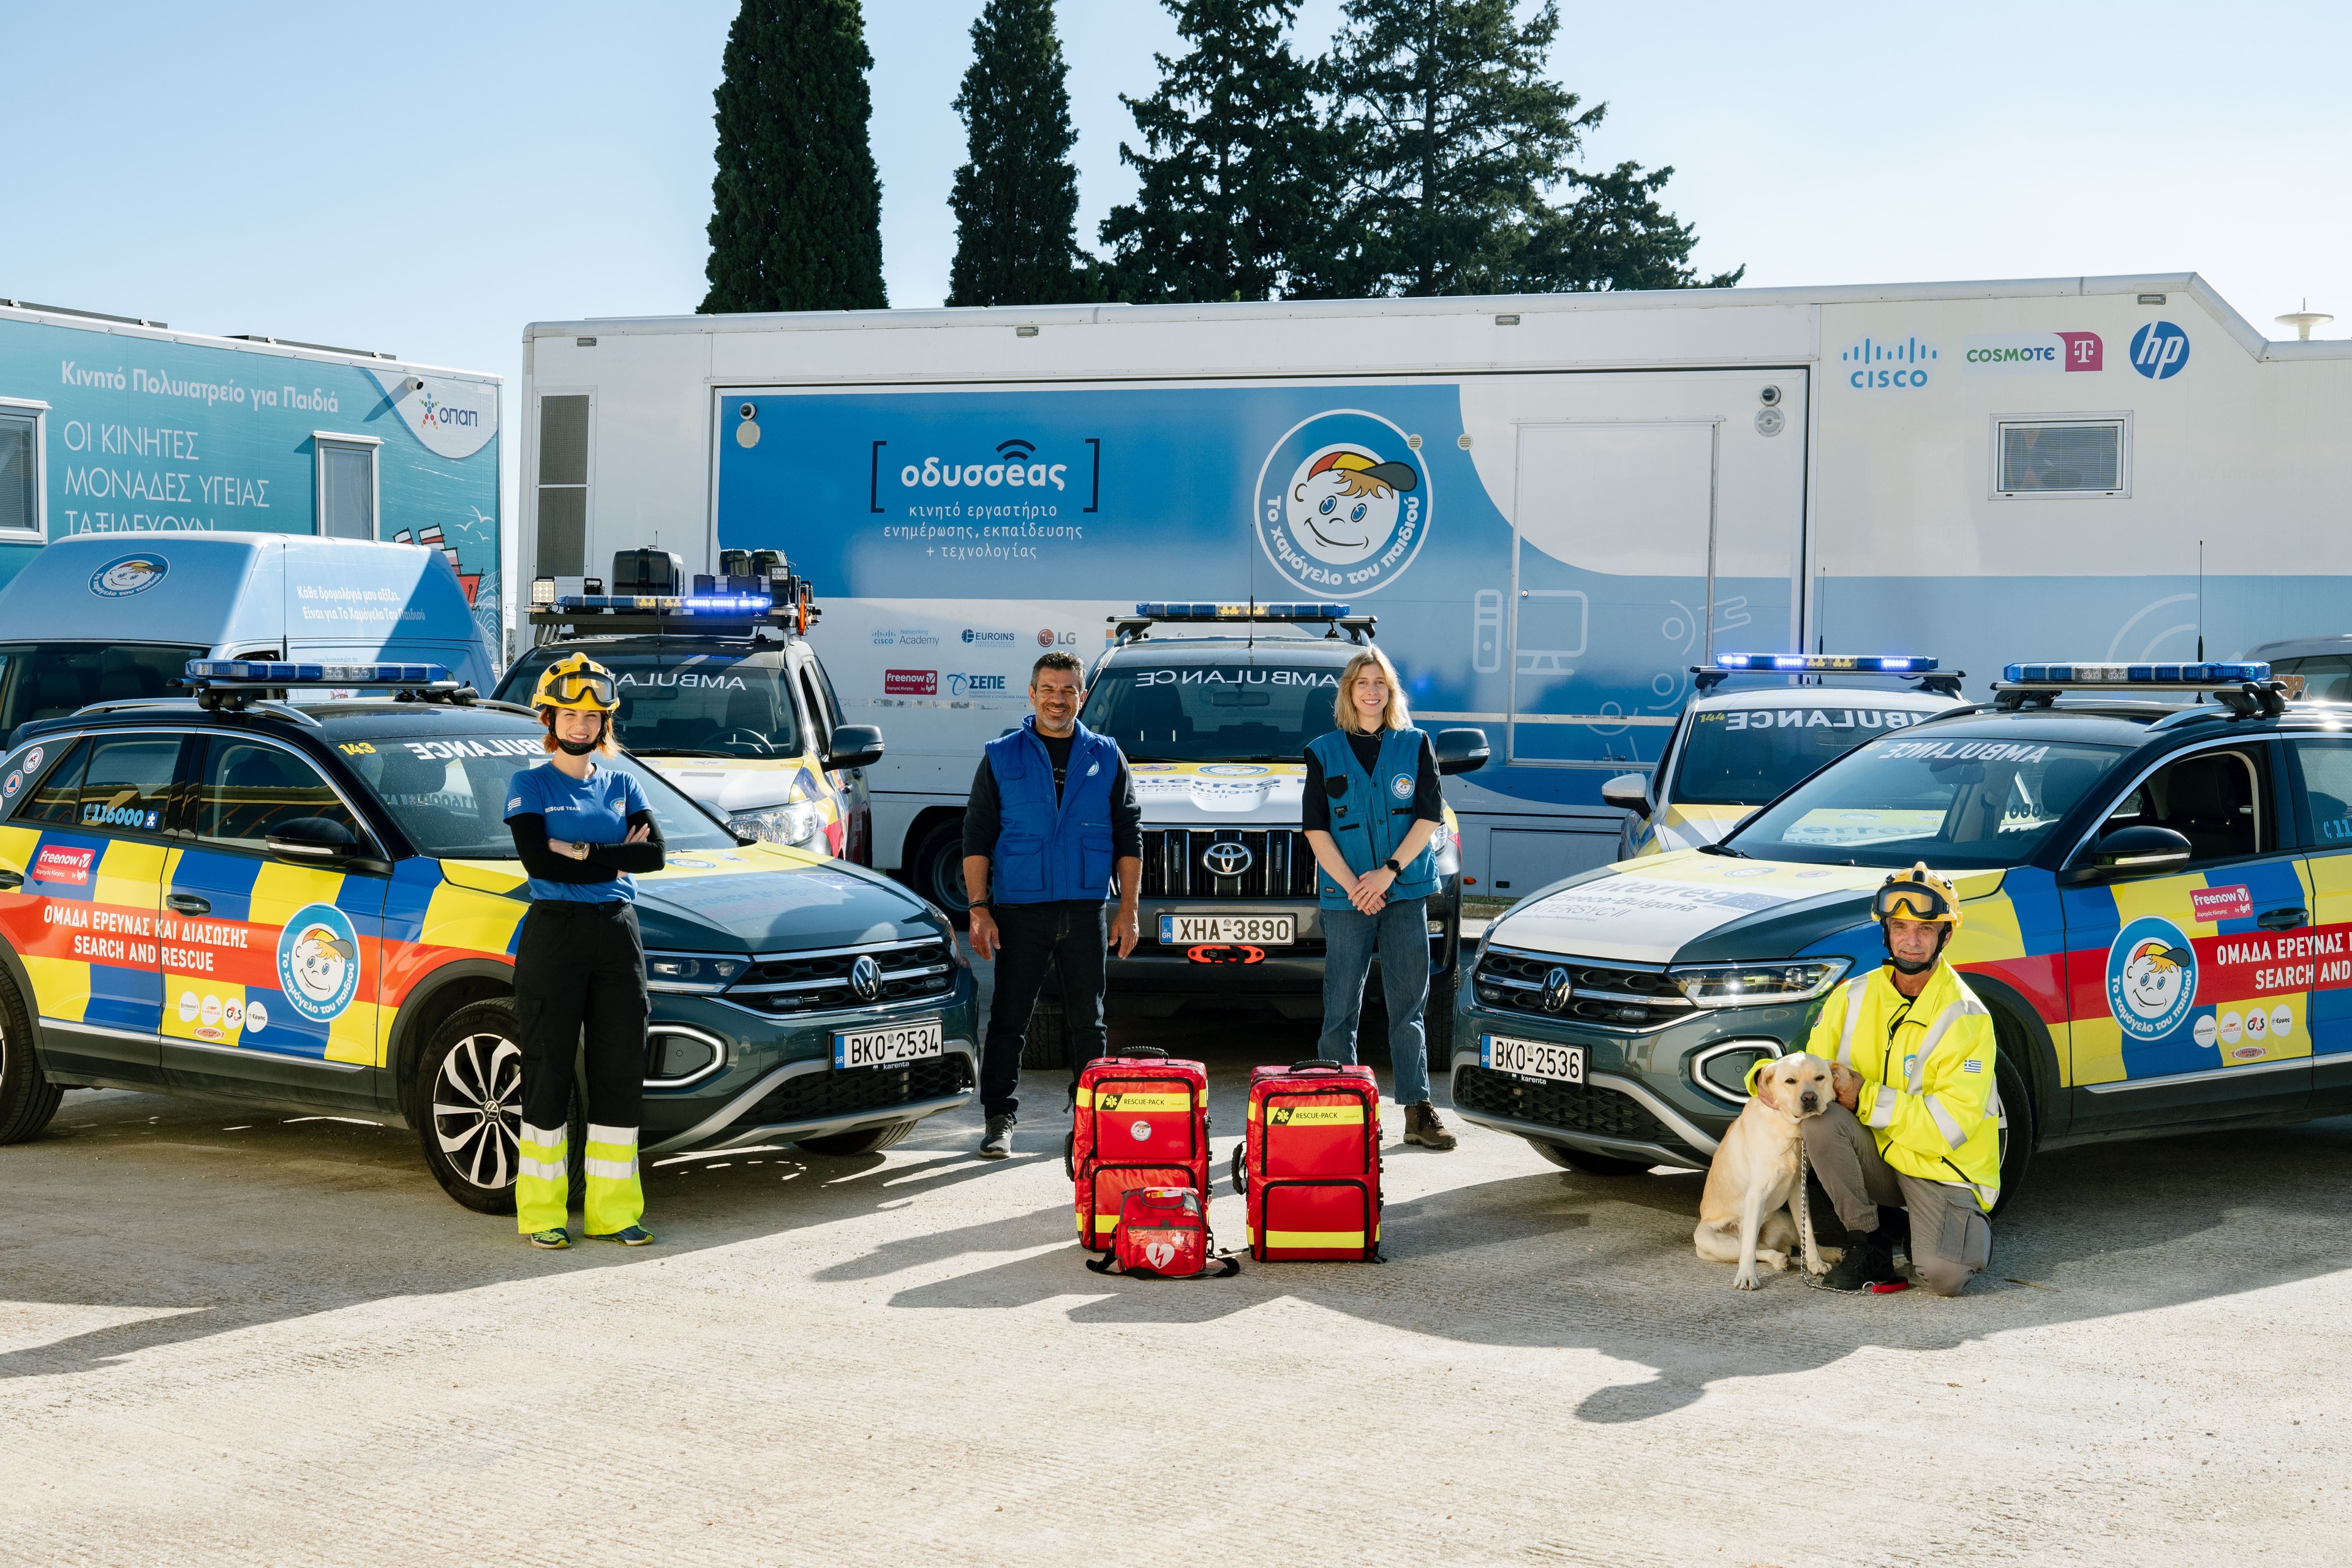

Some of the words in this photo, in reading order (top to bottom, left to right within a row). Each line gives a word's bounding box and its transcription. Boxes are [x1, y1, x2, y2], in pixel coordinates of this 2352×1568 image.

[1966, 347, 2055, 363] COSMOTE
[62, 360, 126, 390] Κινητό
[134, 368, 244, 406] Πολυιατρείο
[251, 388, 277, 411] για
[284, 386, 338, 413] Παιδιά
[1850, 369, 1928, 388] CISCO
[64, 420, 91, 451] ΟΙ
[102, 424, 199, 460] ΚΙΝΗΤΕΣ
[65, 465, 191, 502] ΜΟΝΑΔΕΣ
[199, 475, 270, 508] ΥΓΕΙΑΣ
[909, 501, 960, 520] κινητό
[967, 501, 1057, 519] εργαστήριο
[1270, 525, 1342, 586] χαμόγελο
[1347, 564, 1380, 584] του
[1380, 497, 1419, 568] παιδιού
[941, 543, 1036, 560] τεχνολογίας
[296, 586, 318, 599] Κάθε
[363, 590, 377, 603] μου
[302, 606, 323, 619] Είναι
[324, 608, 338, 622] για
[337, 607, 348, 619] Το
[384, 608, 398, 620] Του
[900, 635, 940, 646] Academy
[1058, 632, 1076, 645] LG
[969, 676, 1005, 689] ΣΕΠΕ
[1699, 712, 1725, 723] 144
[338, 742, 376, 756] 143
[92, 804, 144, 827] 116000
[1573, 880, 1738, 903] Interreg
[1548, 894, 1698, 912] Greece-Bulgaria
[44, 905, 88, 928] ΟΜΑΔΑ
[93, 911, 150, 937] ΕΡΕΥΝΑΣ
[154, 919, 177, 940] ΚΑΙ
[182, 922, 248, 948] ΔΙΑΣΩΣΗΣ
[74, 935, 124, 959] SEARCH
[129, 942, 156, 963] AND
[162, 947, 214, 971] RESCUE
[2217, 941, 2272, 965] ΟΜΑΔΑ
[2277, 932, 2343, 959] ΕΡΕΥΝΑΣ
[2255, 964, 2314, 990] SEARCH
[2320, 960, 2351, 982] AND
[320, 1003, 336, 1014] του
[2155, 1016, 2173, 1030] του
[2247, 1017, 2264, 1031] G4S
[883, 1061, 910, 1070] karenta
[1521, 1074, 1547, 1085] karenta
